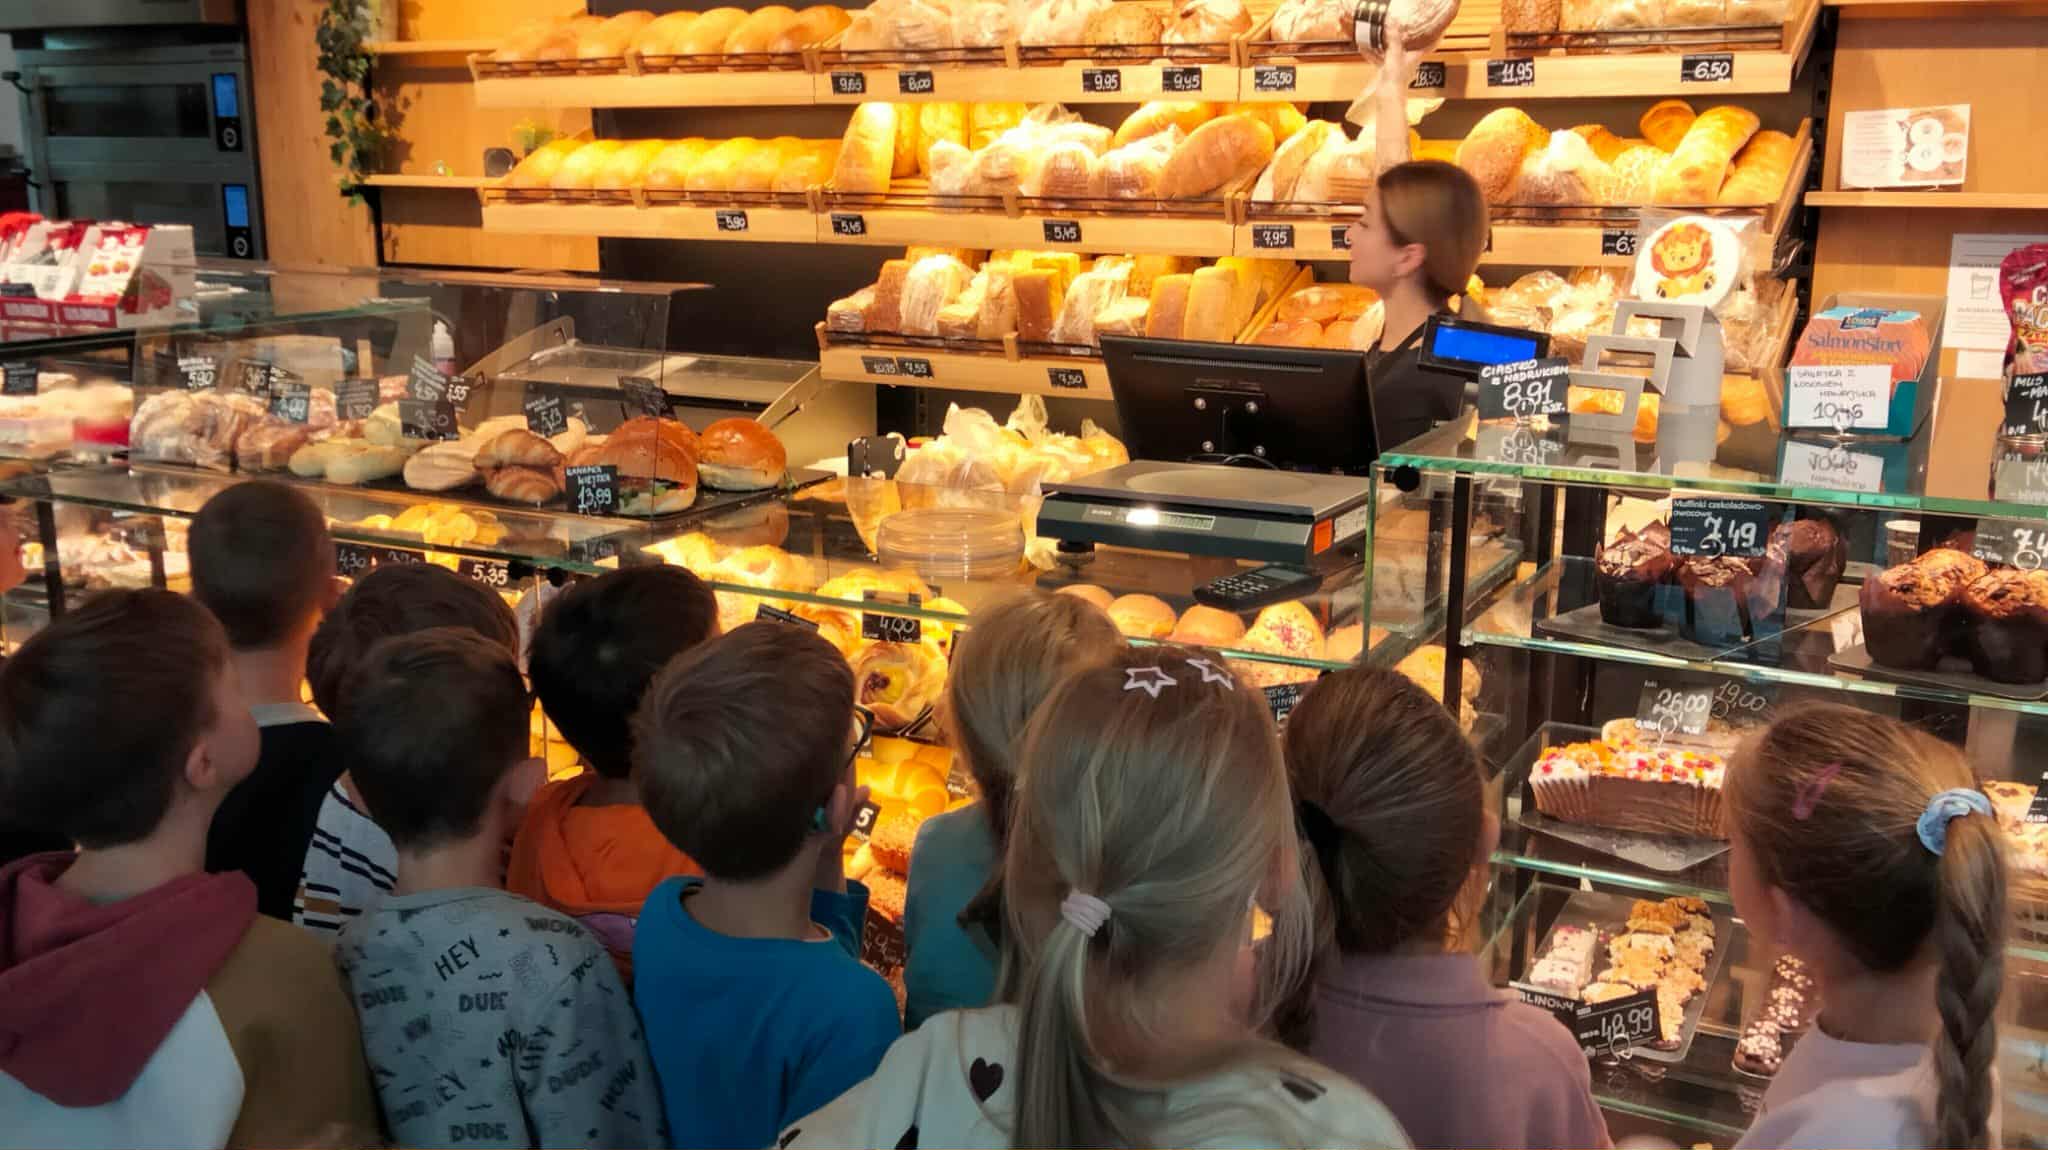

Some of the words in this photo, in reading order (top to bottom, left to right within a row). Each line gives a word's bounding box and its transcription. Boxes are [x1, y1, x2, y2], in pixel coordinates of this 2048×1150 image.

[1263, 71, 1293, 87] 25,50
[1501, 62, 1533, 83] 11,95
[1694, 61, 1730, 79] 6,50
[1094, 74, 1118, 90] 9,95
[471, 563, 509, 586] 5,35
[434, 934, 480, 982] HEY
[1601, 1006, 1654, 1041] 48,99
[449, 1122, 510, 1143] DUDE
